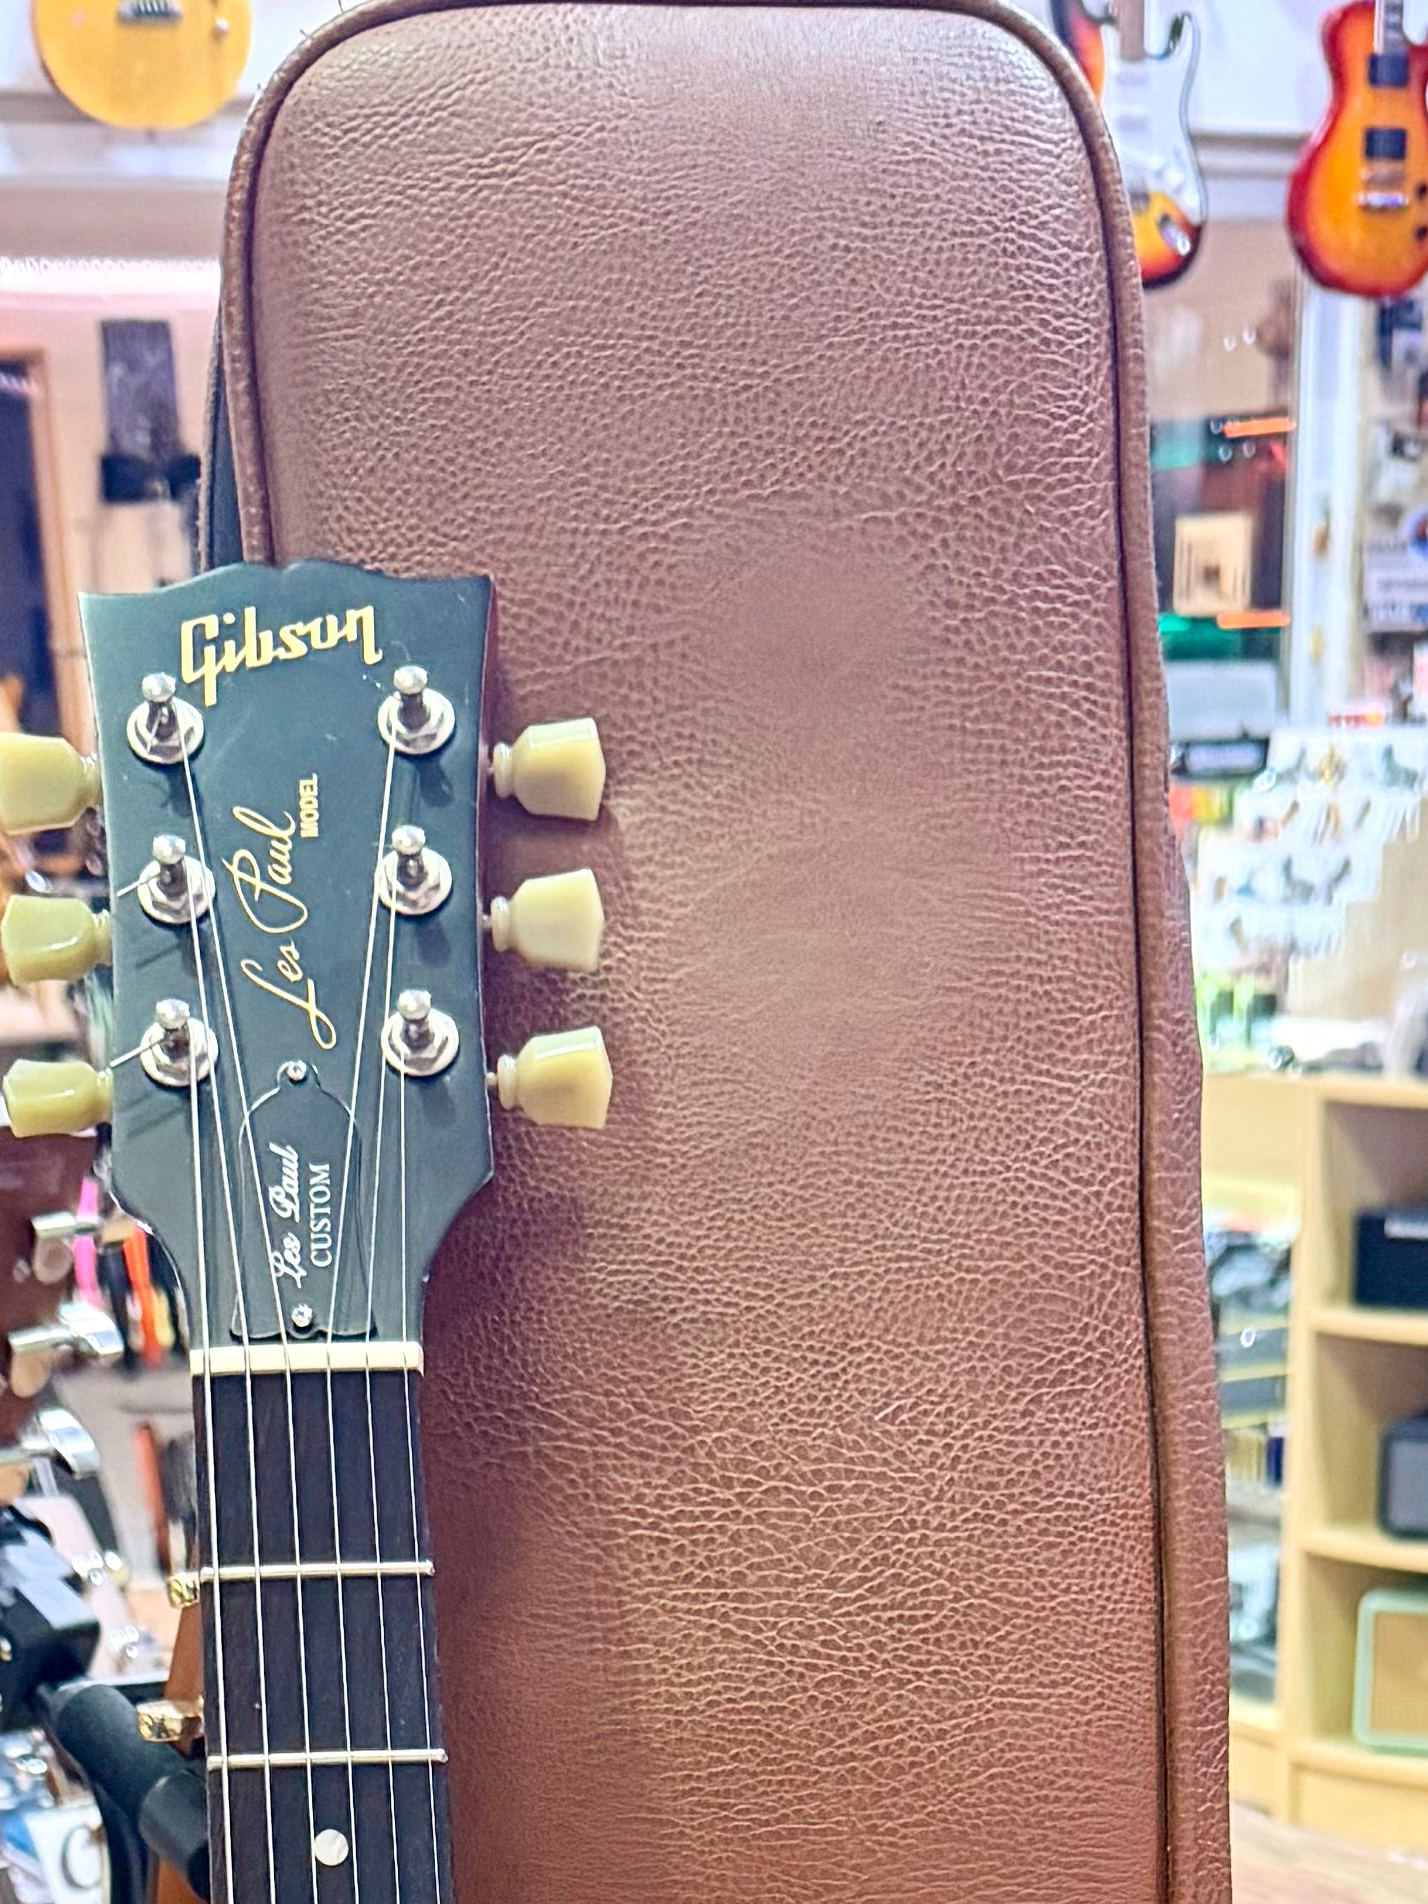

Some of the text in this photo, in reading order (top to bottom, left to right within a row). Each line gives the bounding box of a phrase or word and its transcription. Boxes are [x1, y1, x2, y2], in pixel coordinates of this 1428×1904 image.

[180, 605, 383, 706] Gibson
[299, 773, 319, 839] MODEL
[222, 806, 336, 1051] Les Paul
[269, 1142, 308, 1289] Les Paul
[308, 1163, 333, 1268] CUSTOM
